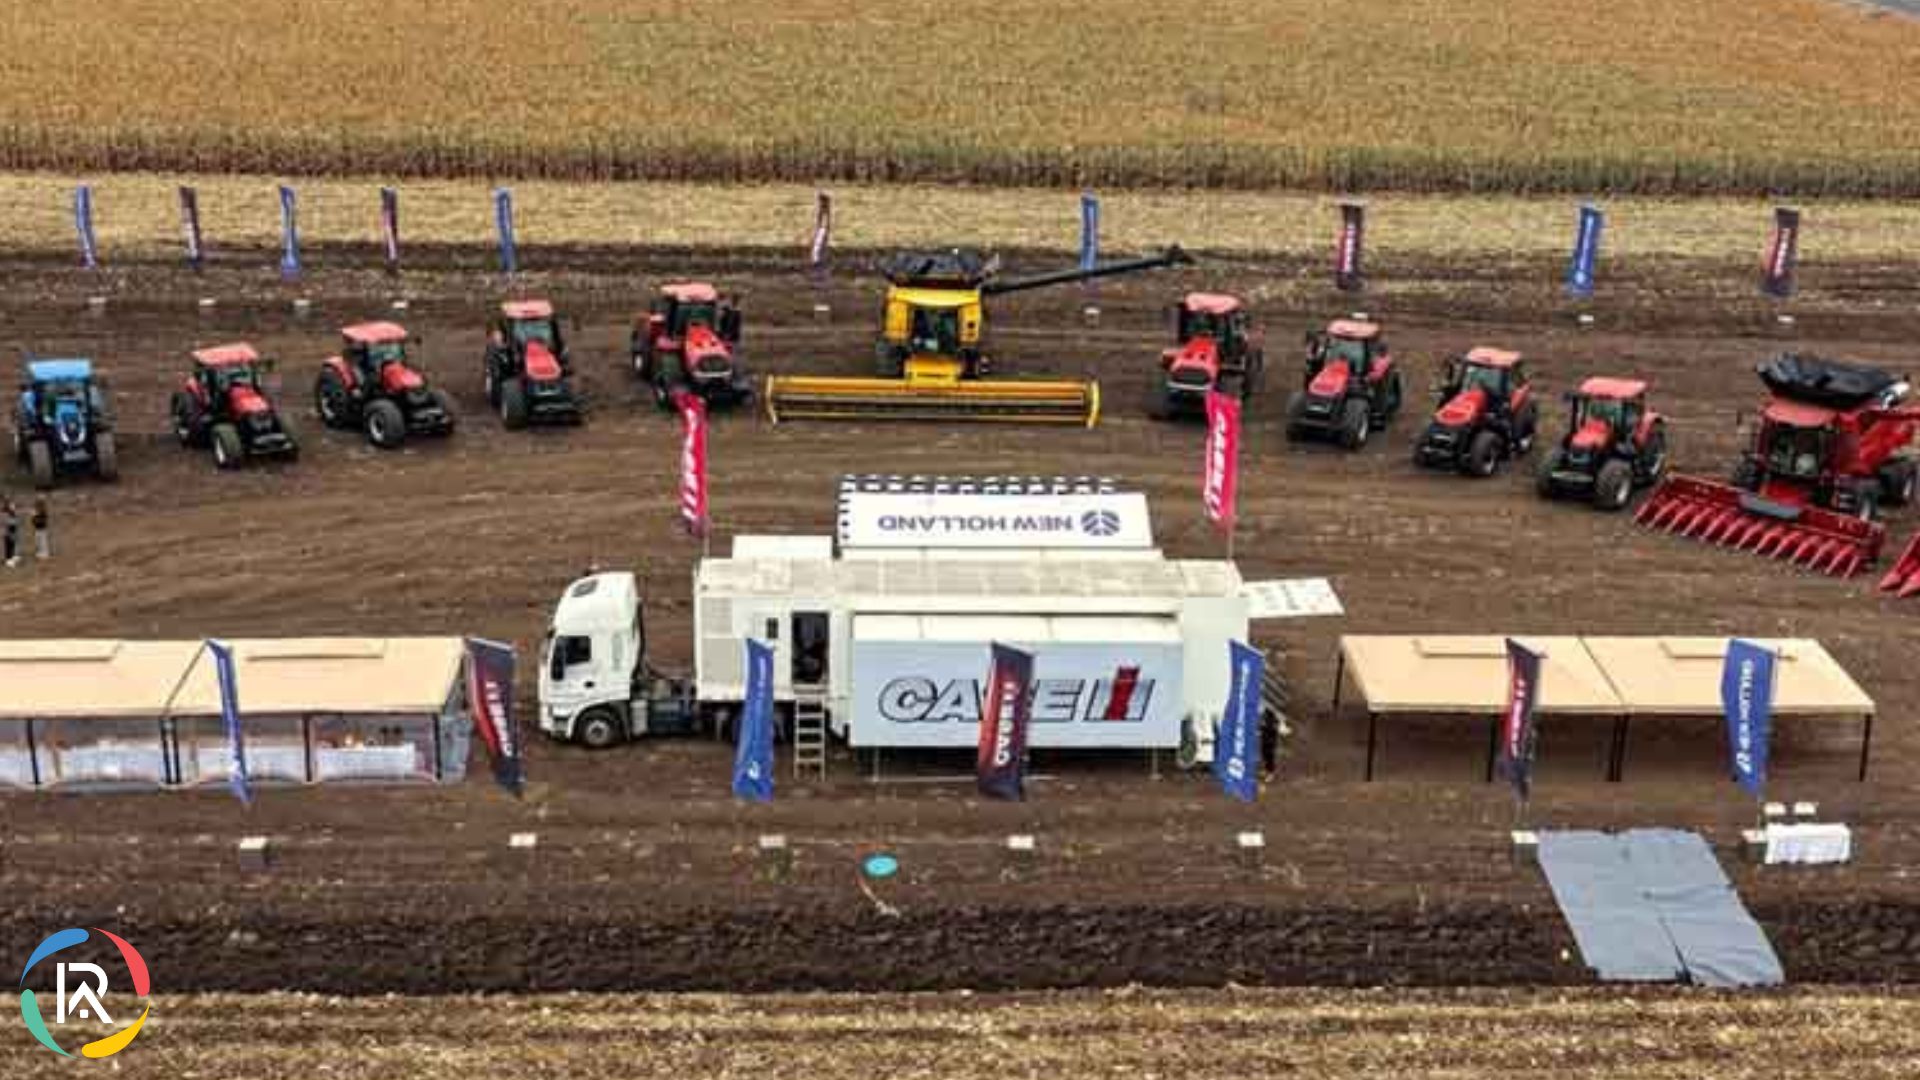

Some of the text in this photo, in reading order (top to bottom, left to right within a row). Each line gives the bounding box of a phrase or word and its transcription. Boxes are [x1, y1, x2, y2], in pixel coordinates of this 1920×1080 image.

[877, 515, 1073, 532] NEW HOLLAND
[878, 677, 1085, 722] CAE
